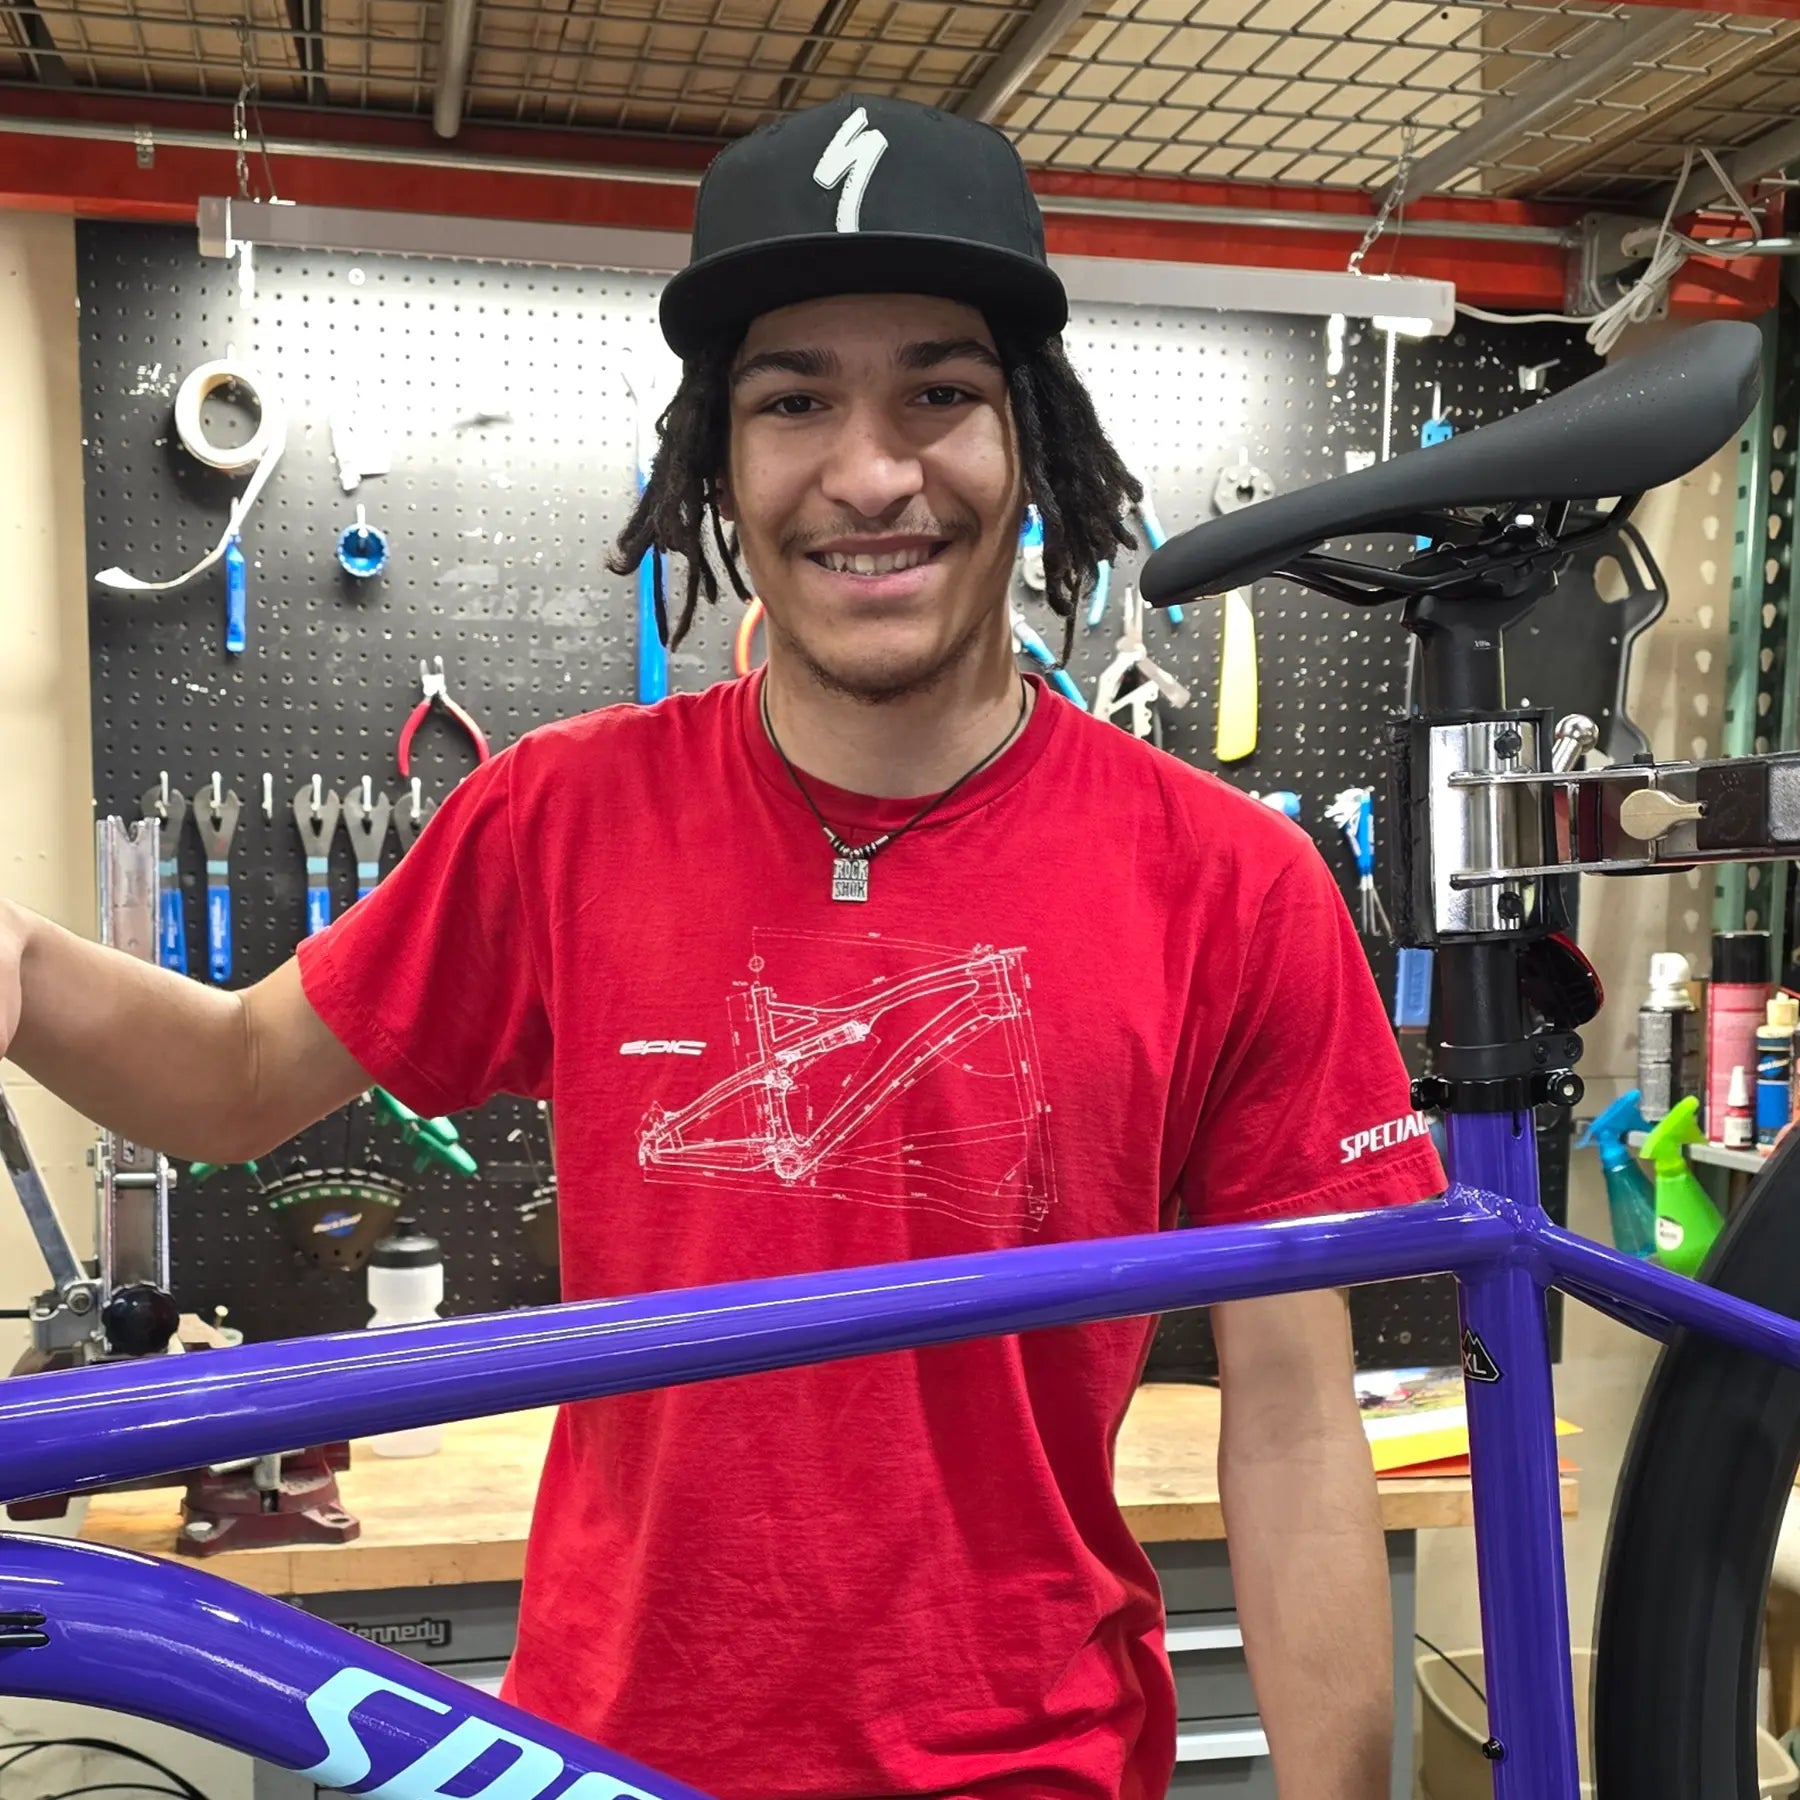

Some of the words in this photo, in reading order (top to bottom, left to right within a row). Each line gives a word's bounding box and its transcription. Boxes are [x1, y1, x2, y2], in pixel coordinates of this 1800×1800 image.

[833, 859, 868, 879] ROCK
[619, 1040, 707, 1056] EPIC
[1462, 1350, 1487, 1375] XL
[348, 1620, 445, 1645] ennedy
